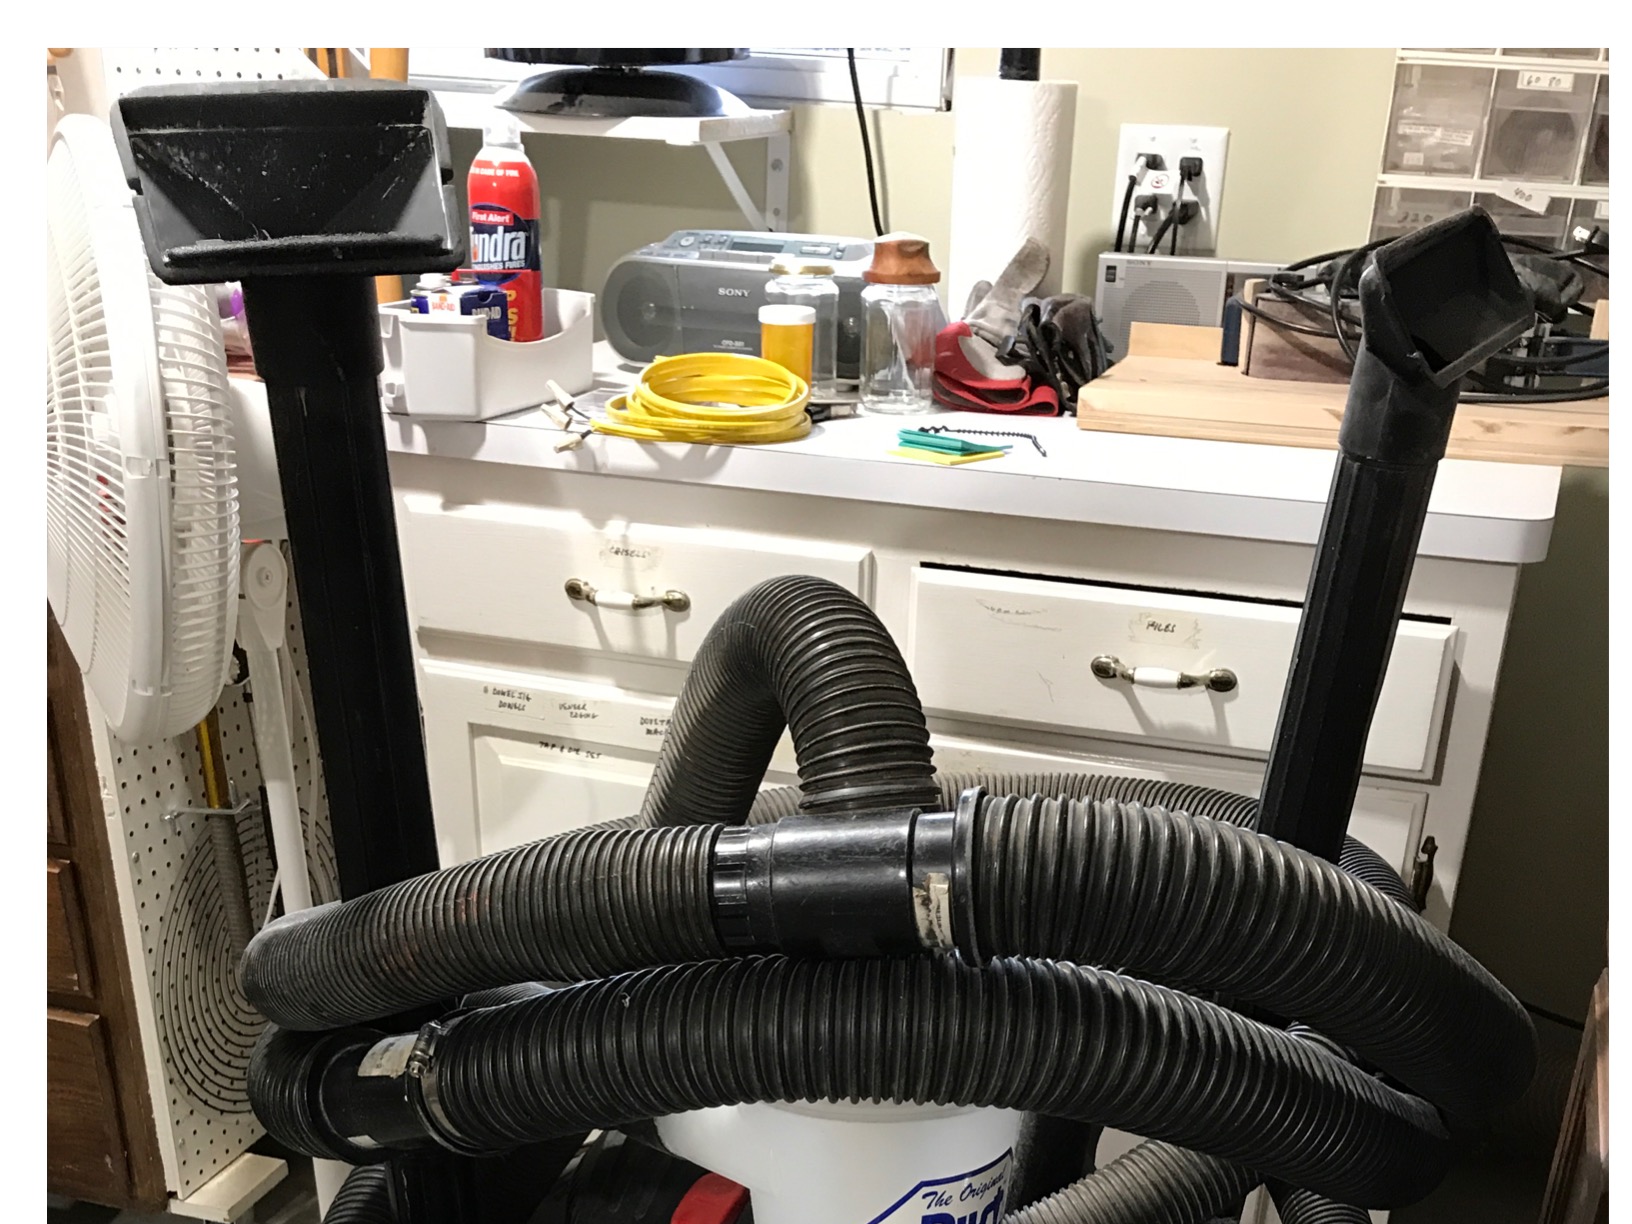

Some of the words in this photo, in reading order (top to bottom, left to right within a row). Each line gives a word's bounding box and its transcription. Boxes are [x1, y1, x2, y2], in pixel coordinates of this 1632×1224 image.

[488, 212, 510, 223] Alert
[470, 225, 527, 262] undra
[717, 287, 751, 297] SONY
[921, 1190, 953, 1210] The
